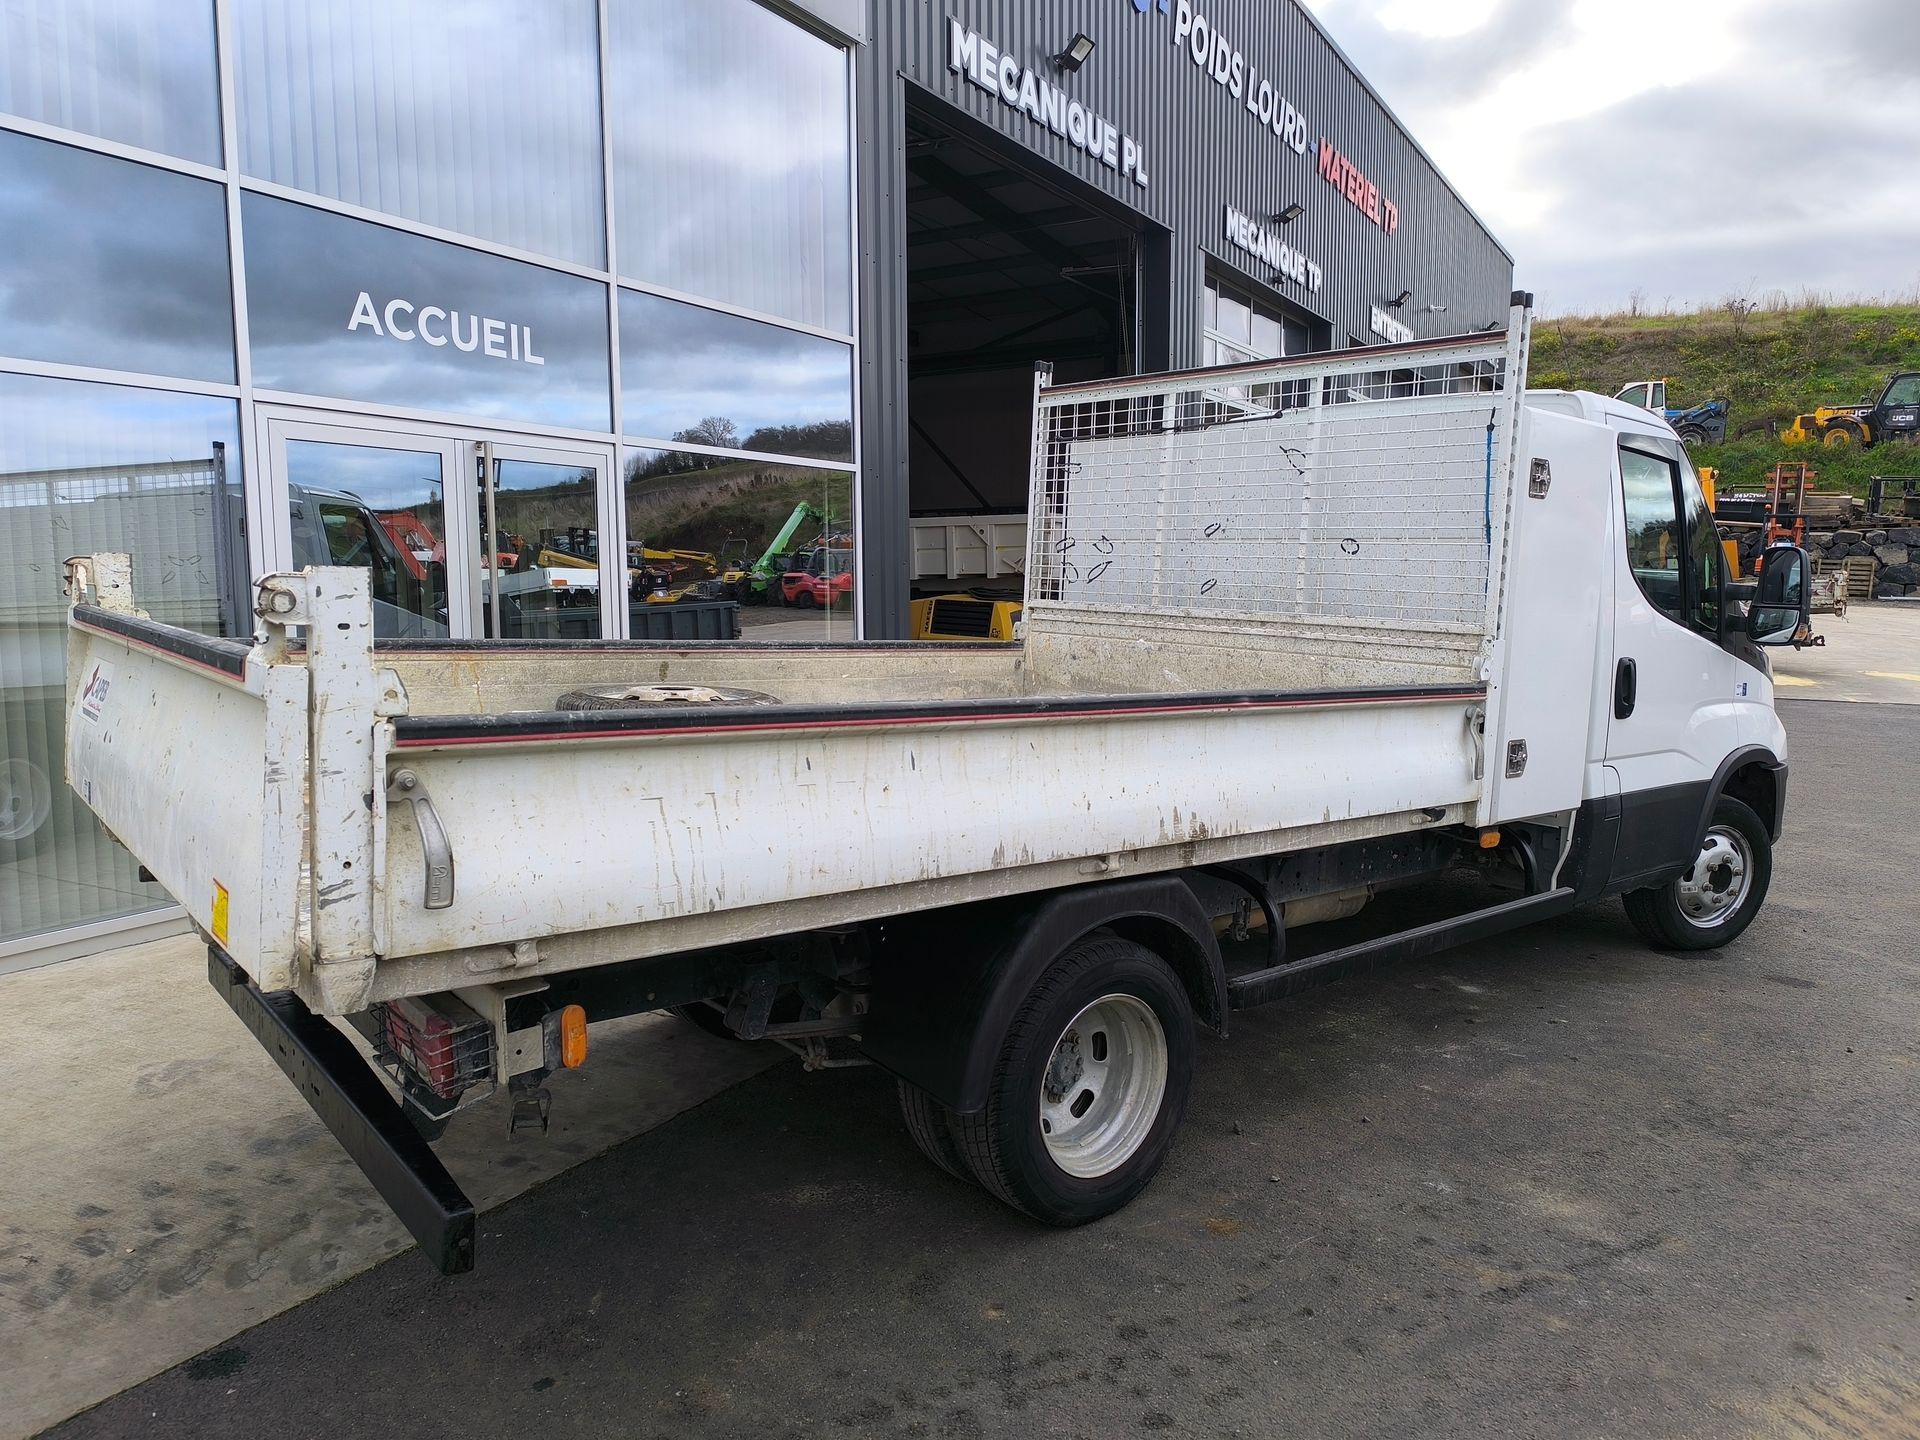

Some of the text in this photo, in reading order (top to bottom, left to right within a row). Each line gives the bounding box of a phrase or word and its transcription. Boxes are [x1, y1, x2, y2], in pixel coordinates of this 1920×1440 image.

[950, 18, 1149, 186] MECANIQUE PL
[1174, 0, 1398, 236] POIDS LOURD MATERIEL TP
[1226, 203, 1321, 293] MECANIQUE TP
[347, 292, 545, 365] ACCUEIL
